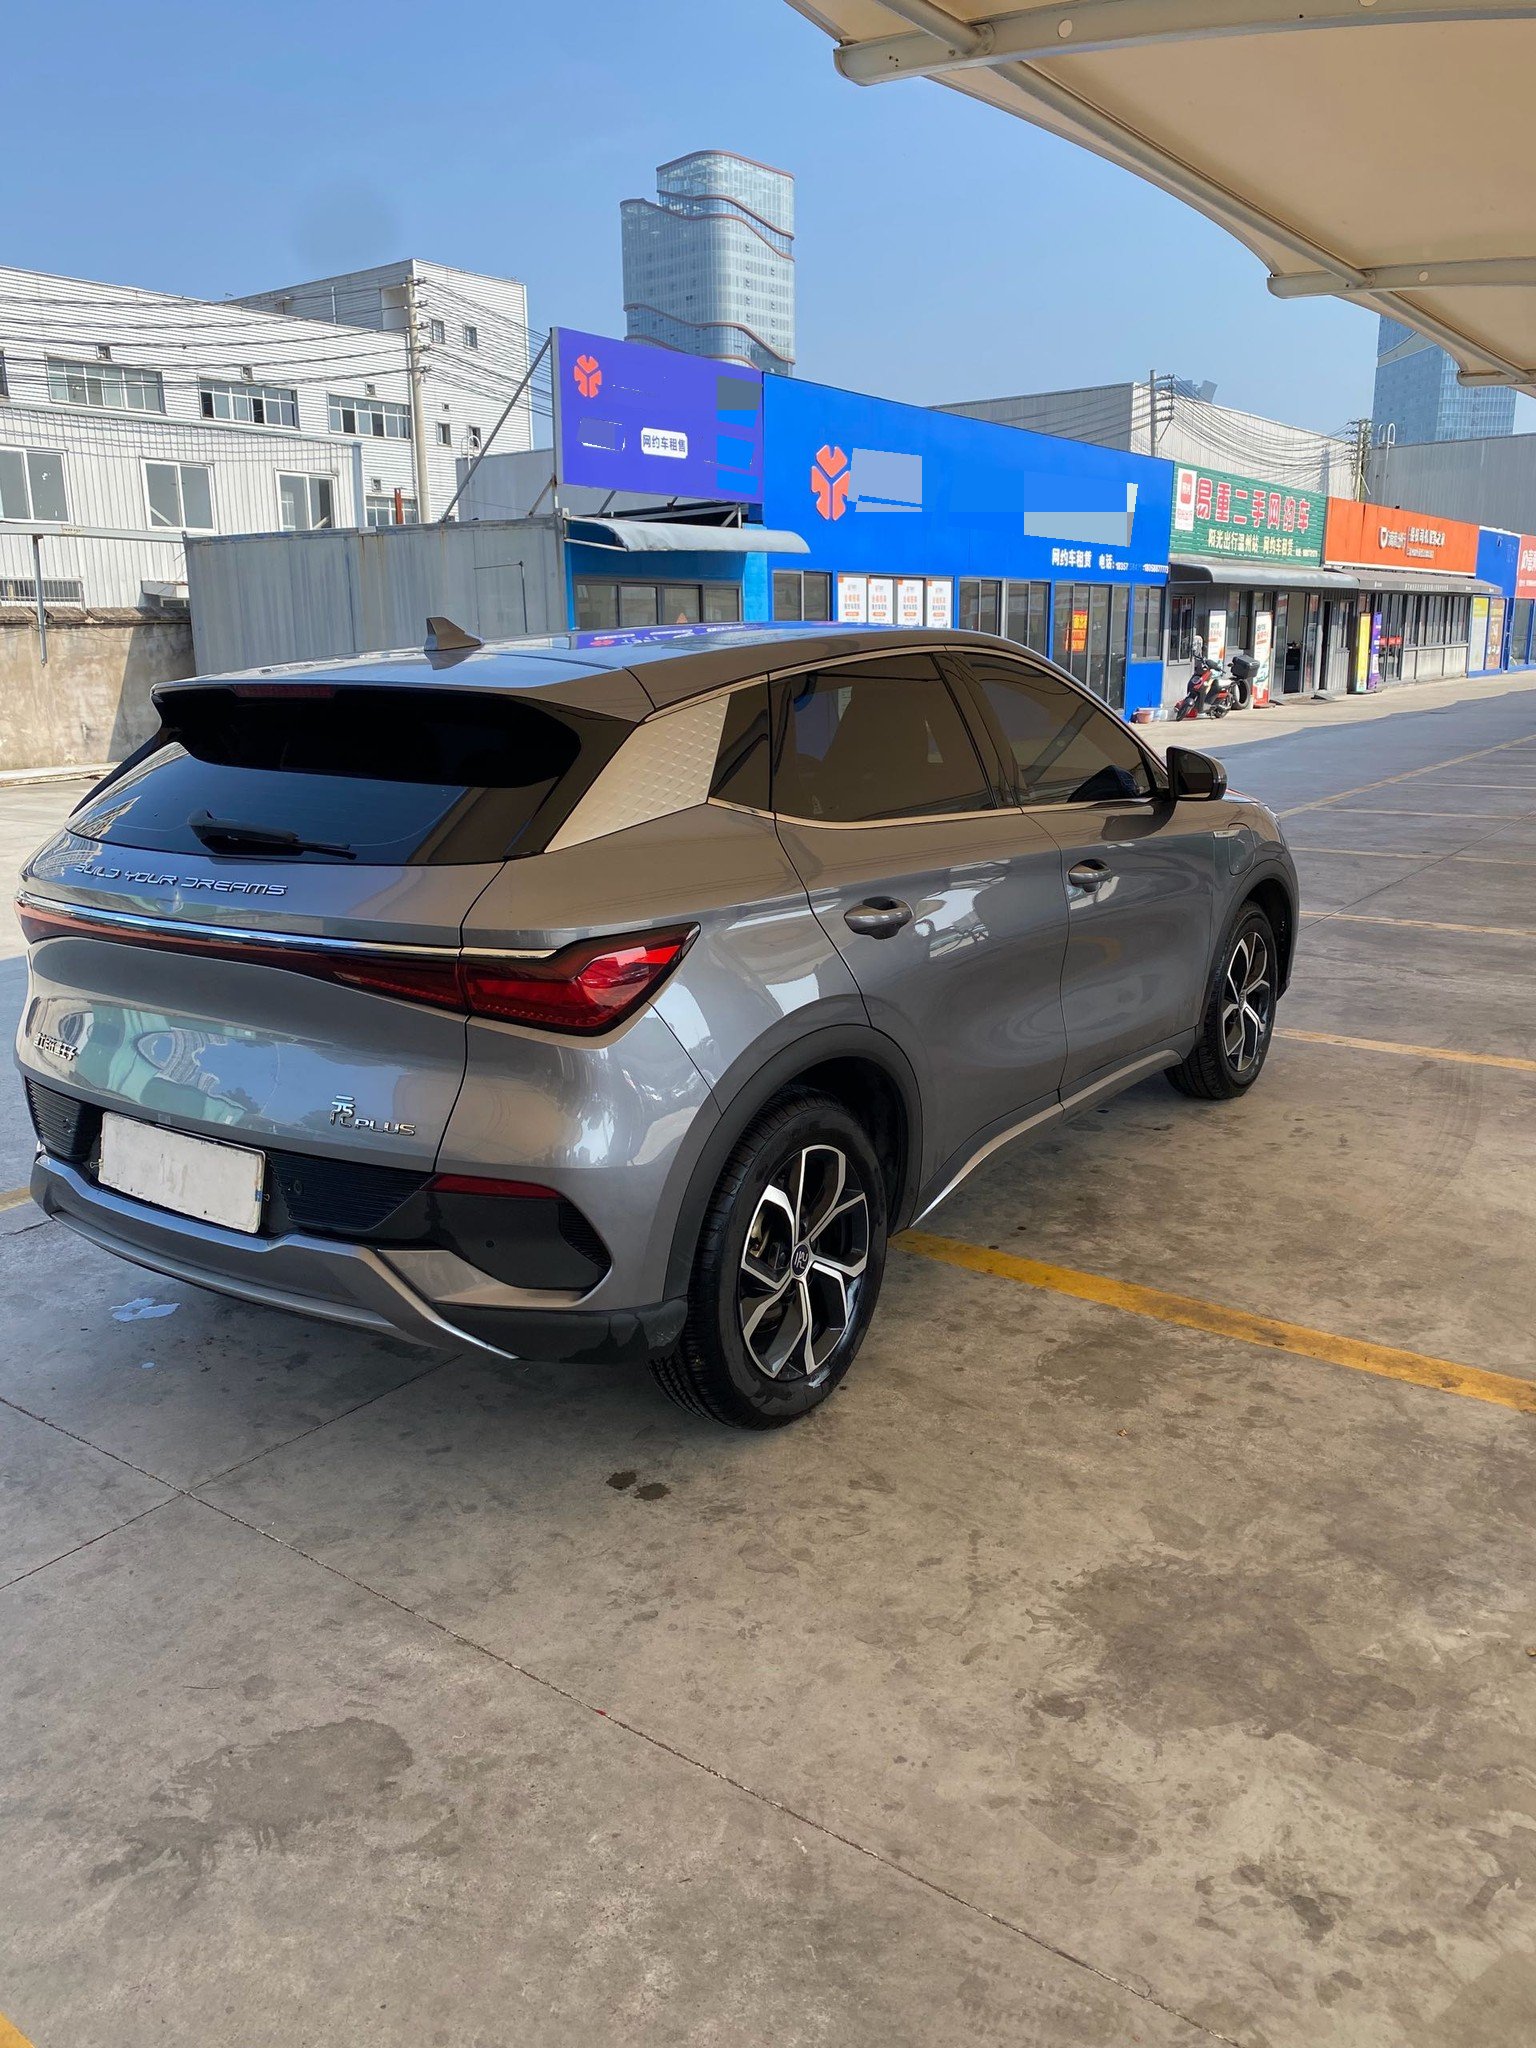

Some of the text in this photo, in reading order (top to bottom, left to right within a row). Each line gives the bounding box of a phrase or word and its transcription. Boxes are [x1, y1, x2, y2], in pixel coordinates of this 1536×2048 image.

[643, 434, 687, 453] 网约车租售
[1052, 548, 1092, 568] 网约车租赁
[124, 871, 179, 886] YOUR
[181, 876, 288, 896] DREAMS
[355, 1118, 416, 1136] PLUS
